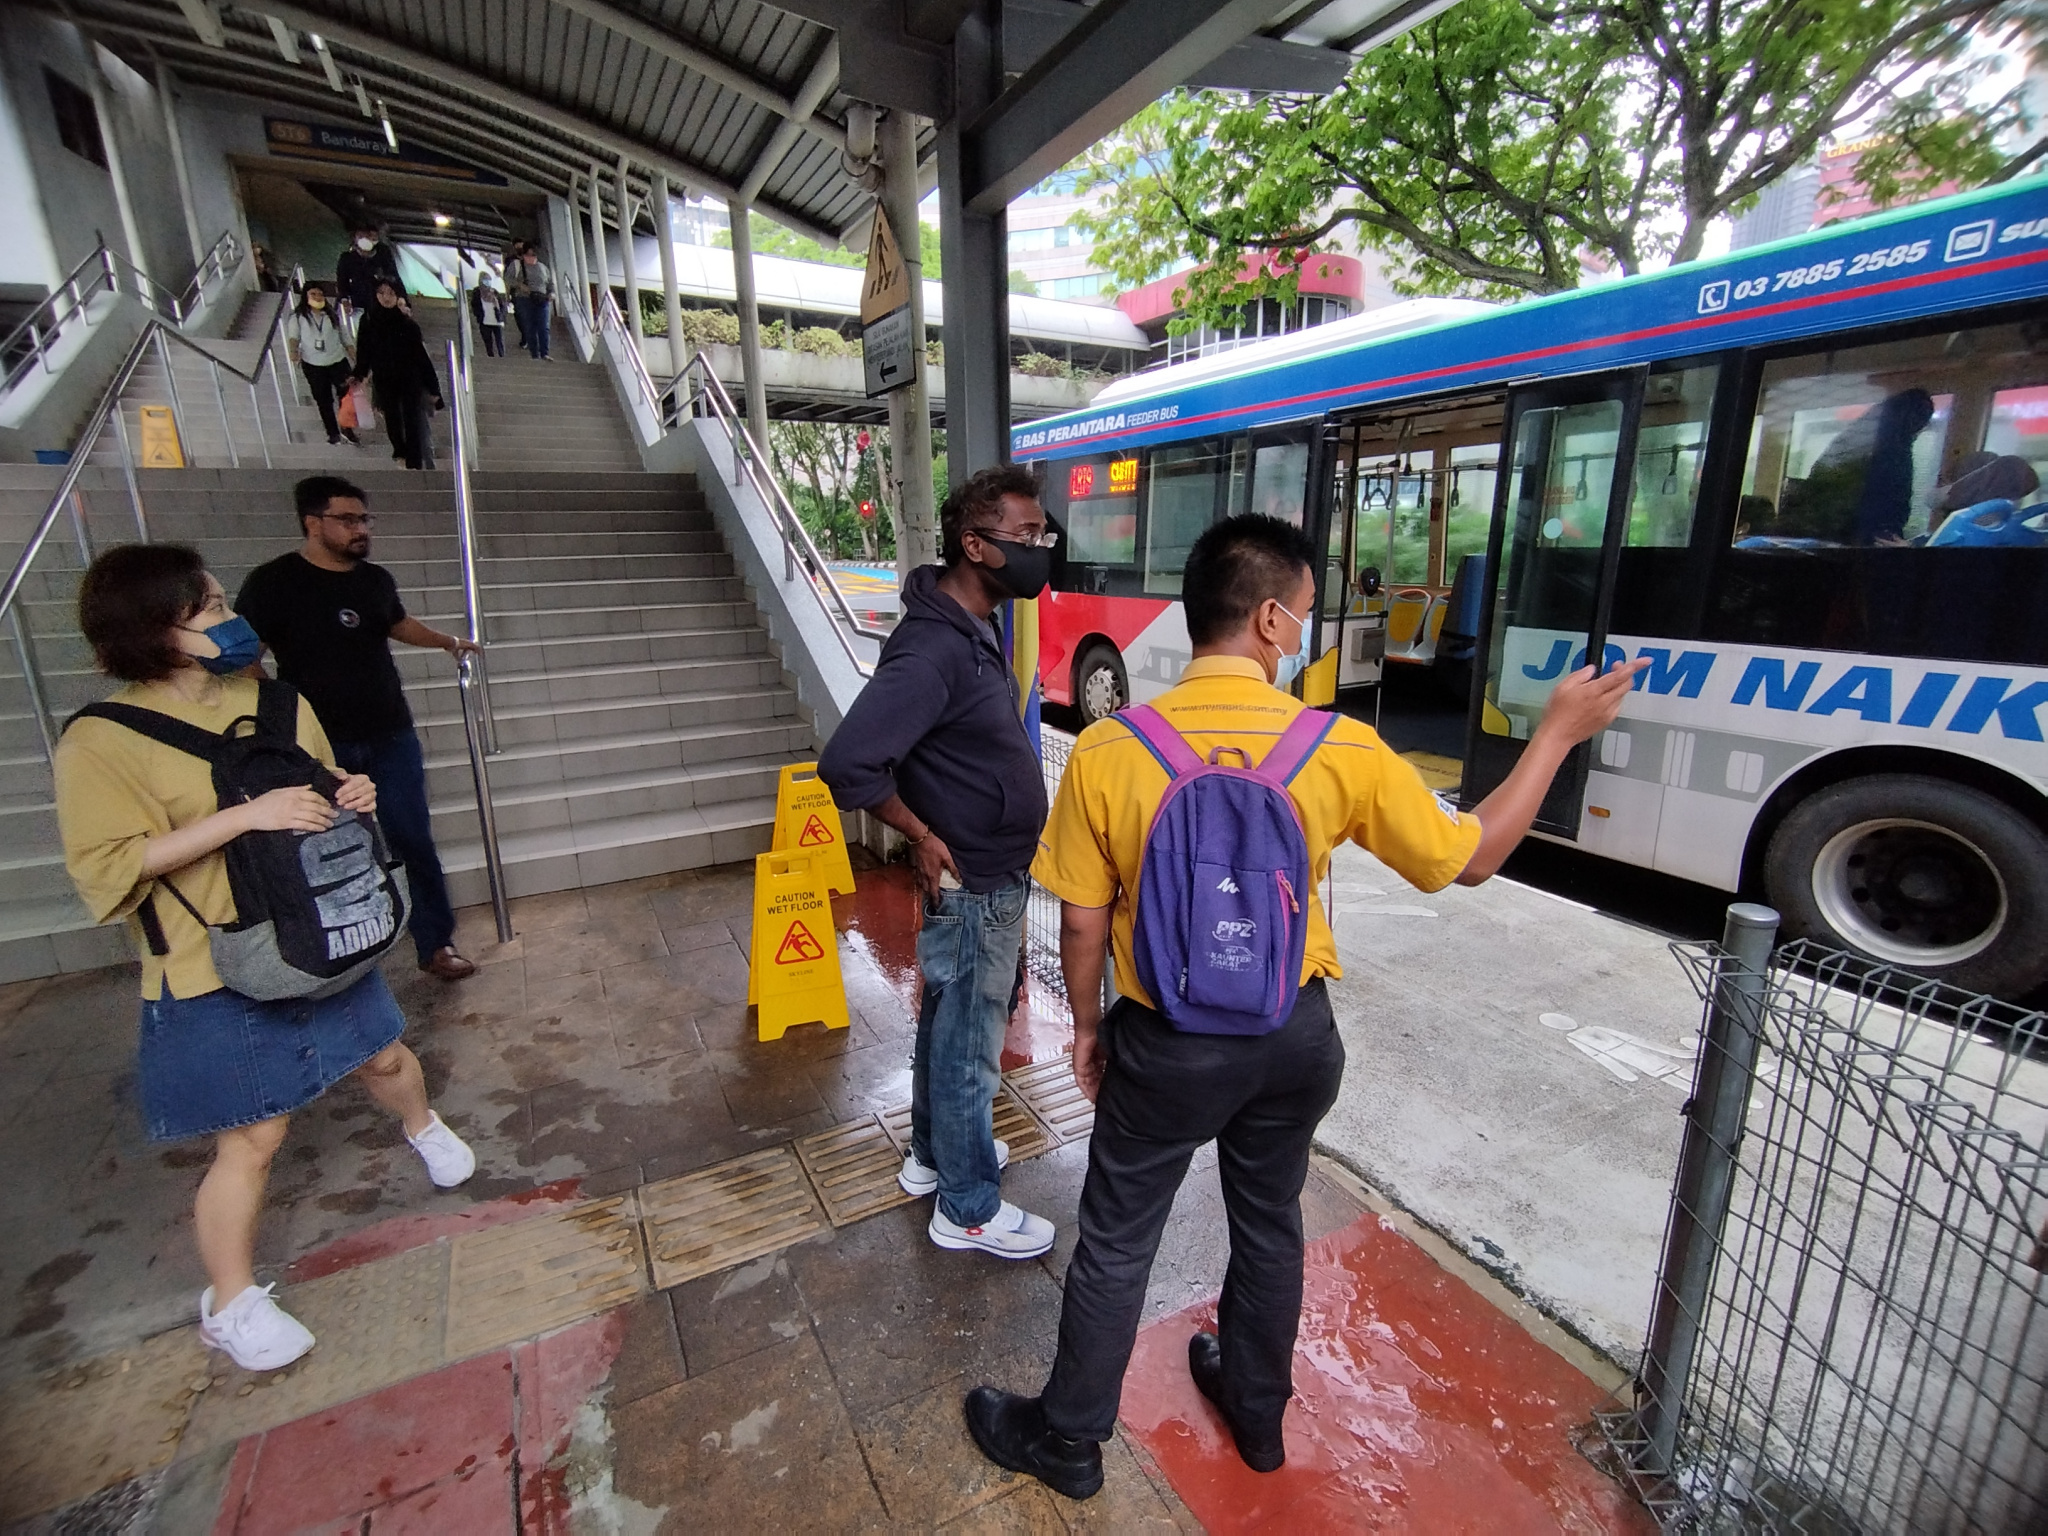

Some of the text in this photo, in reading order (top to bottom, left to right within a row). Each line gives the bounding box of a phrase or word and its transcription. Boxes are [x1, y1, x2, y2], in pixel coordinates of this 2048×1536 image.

[321, 131, 391, 154] Bandaray
[1733, 275, 1770, 300] 03
[1772, 259, 1845, 292] 7885
[1846, 240, 1931, 276] 2585
[1022, 405, 1179, 448] BAS PERANTARA FEEDER BUS
[1730, 656, 2048, 744] NAIK
[791, 799, 832, 810] WET FLOOR
[796, 793, 825, 802] CAUTION
[767, 900, 824, 915] WET FLOOR
[775, 891, 815, 904] CAUTION
[327, 912, 395, 961] ADIDAS
[1216, 920, 1254, 938] PPZ
